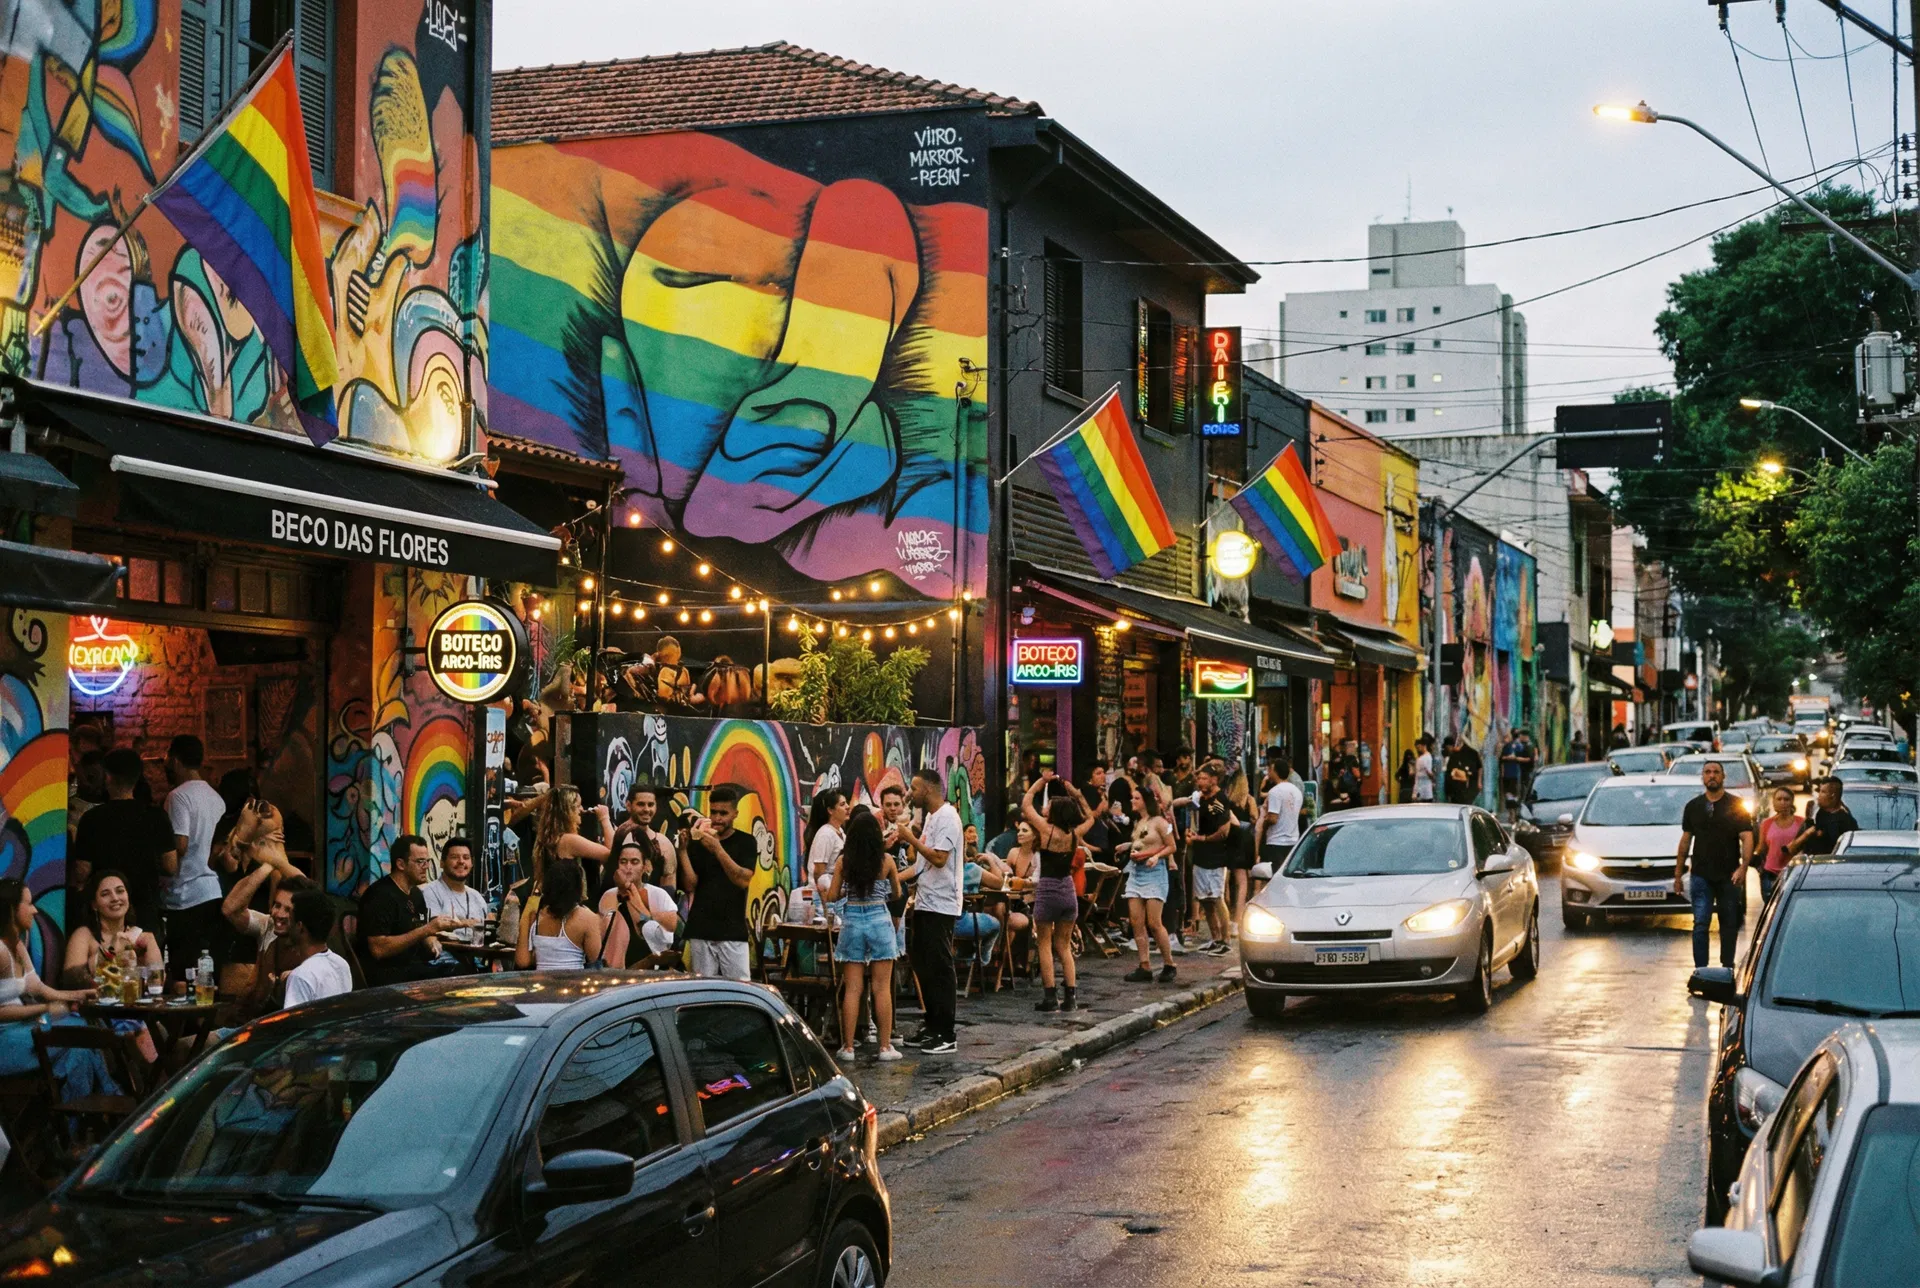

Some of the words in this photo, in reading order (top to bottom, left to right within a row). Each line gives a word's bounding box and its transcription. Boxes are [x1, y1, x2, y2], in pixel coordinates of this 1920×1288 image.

[271, 509, 329, 547] BECO
[334, 520, 374, 554] DAS
[379, 528, 449, 566] FLORES
[440, 633, 503, 653] BOTECO
[440, 651, 503, 670] ARCO-ÍRIS
[1019, 645, 1077, 661] BOTECO
[1016, 660, 1078, 678] ARCO-ÍRIS
